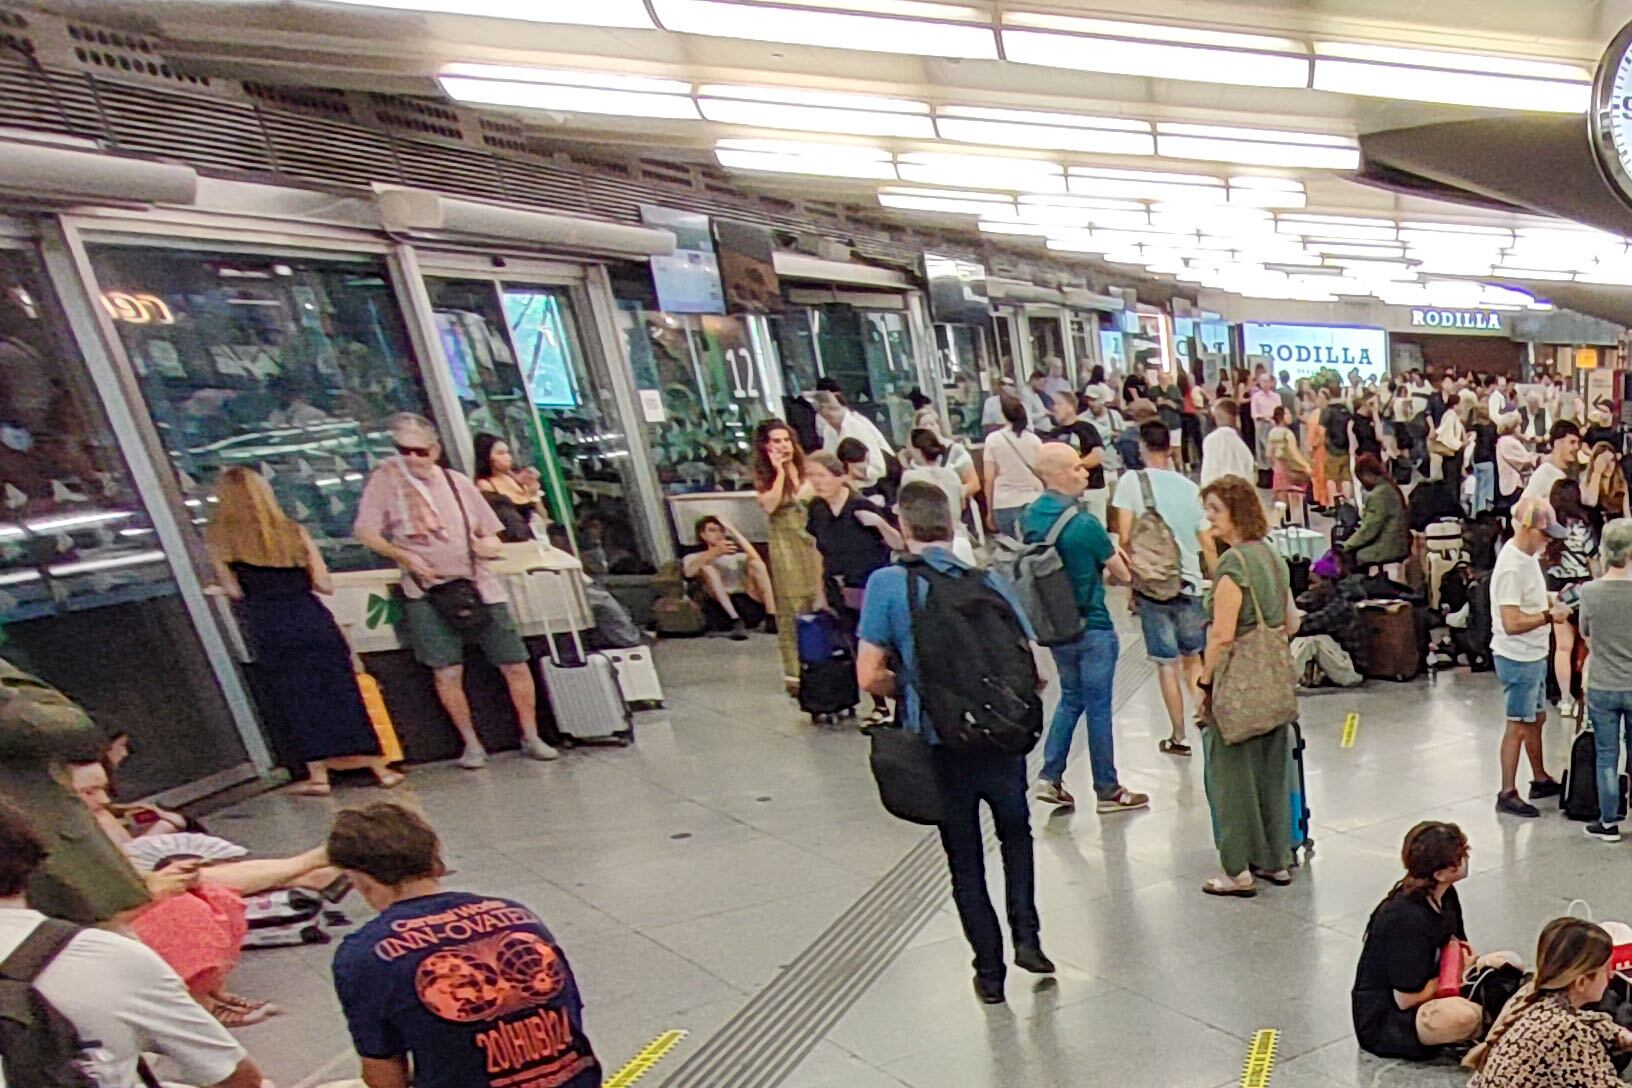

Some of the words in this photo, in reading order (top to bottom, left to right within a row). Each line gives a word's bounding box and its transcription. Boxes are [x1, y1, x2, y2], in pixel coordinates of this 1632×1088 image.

[1411, 309, 1501, 330] RODILLA
[1258, 343, 1373, 365] RODILLA
[725, 347, 760, 398] 12
